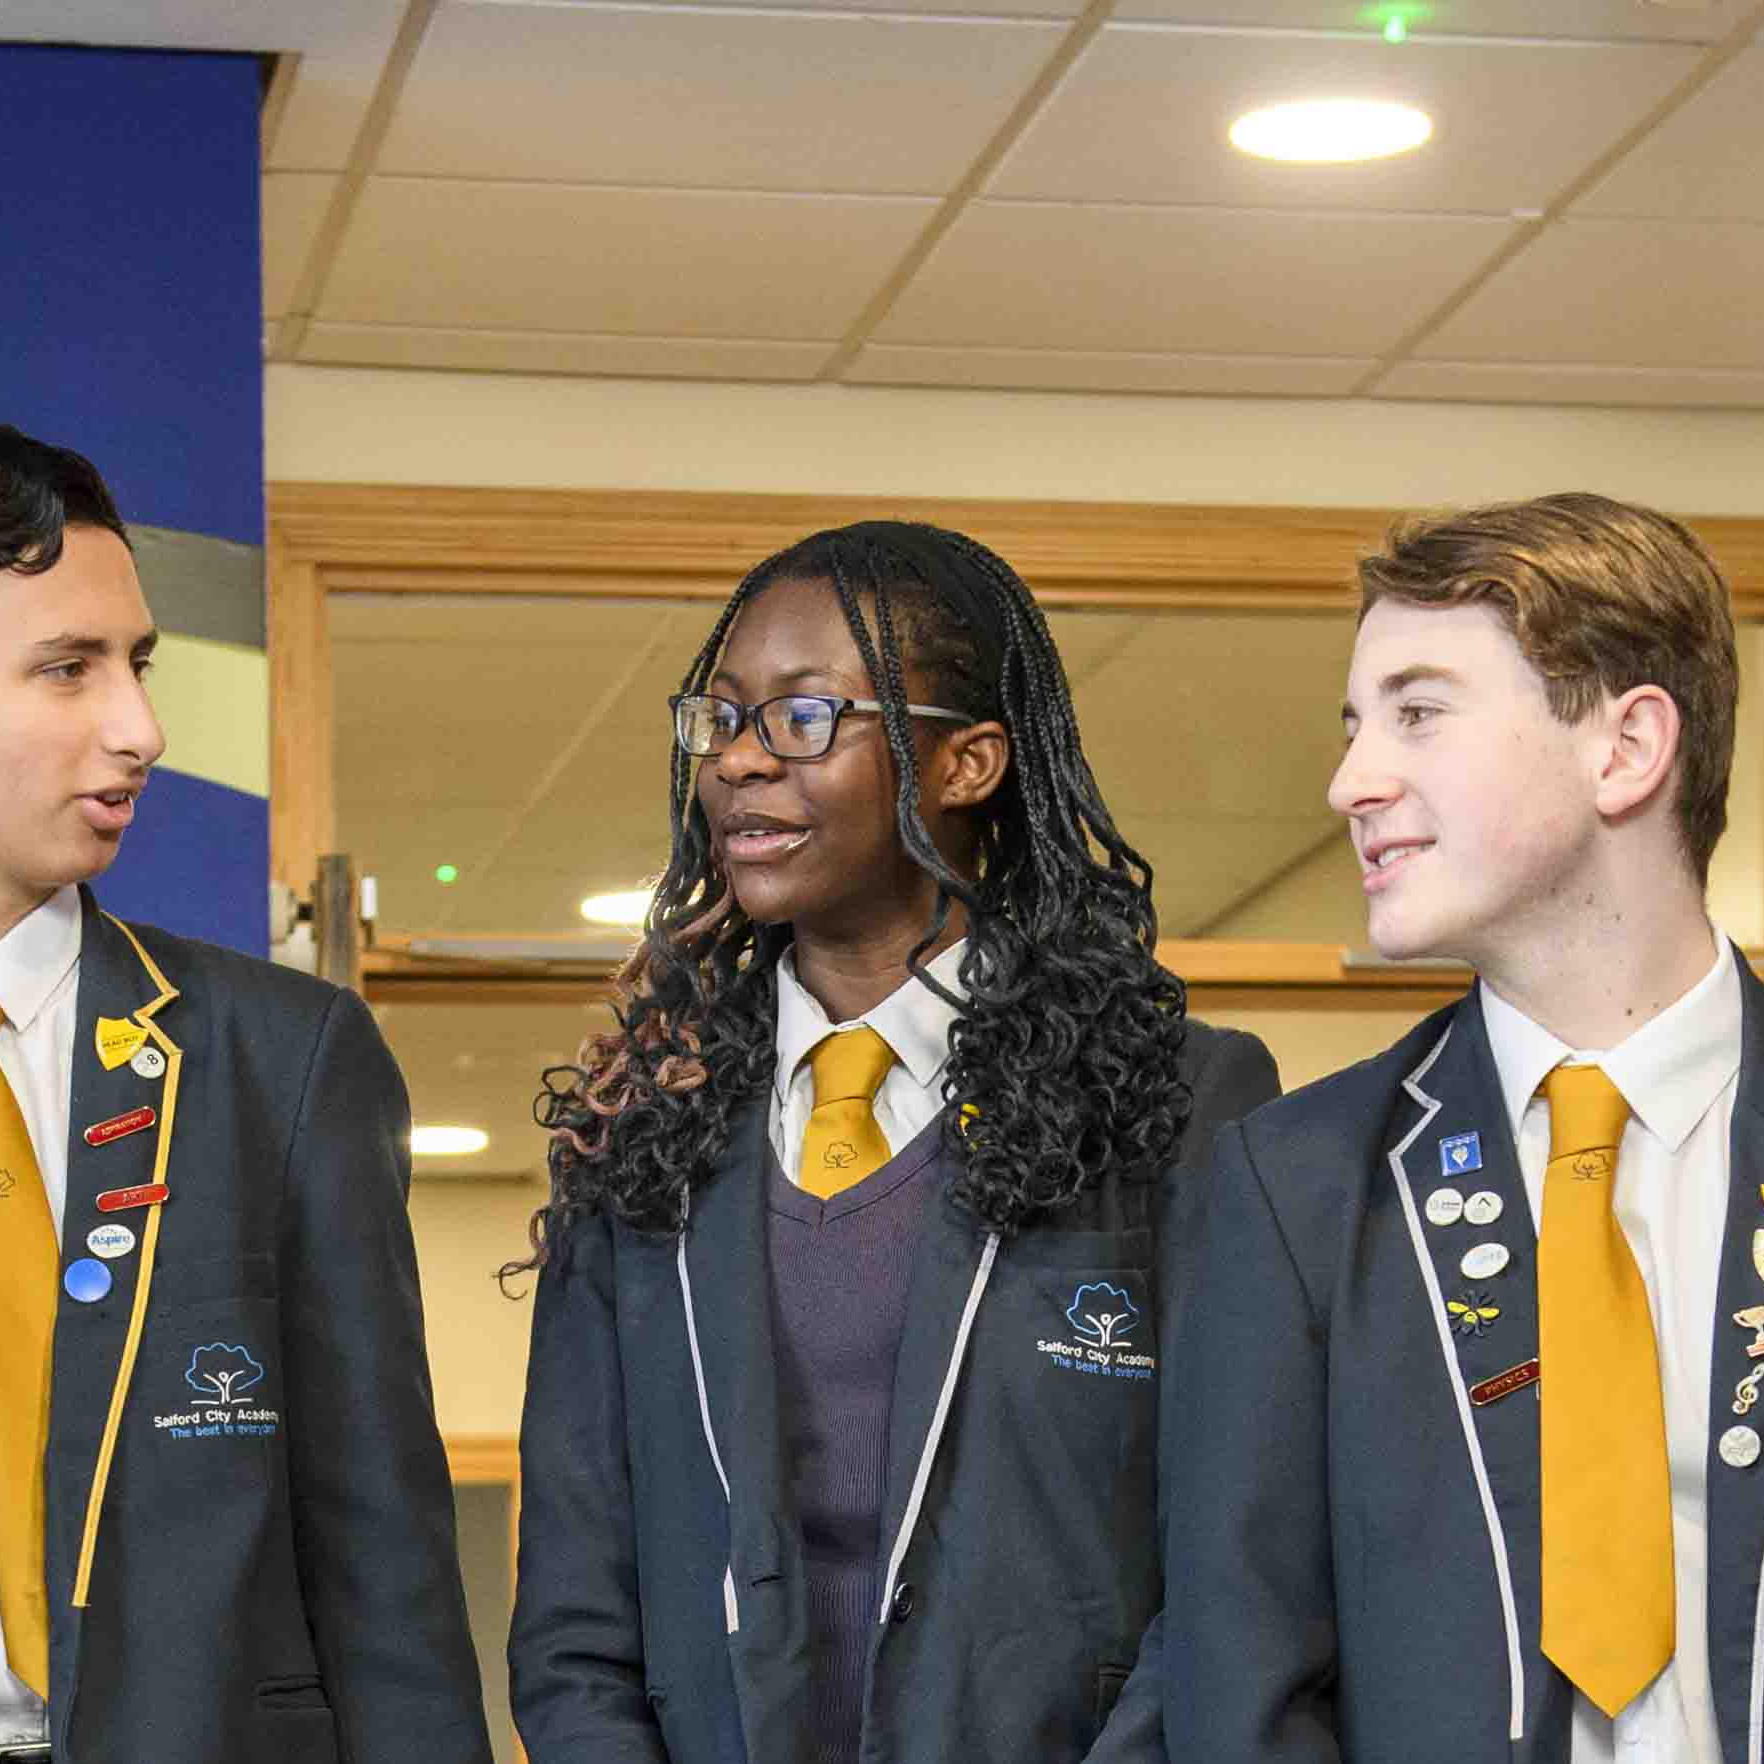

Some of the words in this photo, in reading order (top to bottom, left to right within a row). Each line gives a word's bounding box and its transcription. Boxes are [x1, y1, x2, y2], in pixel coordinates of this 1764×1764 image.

[1037, 1340, 1082, 1357] Salford
[1086, 1349, 1111, 1366] City
[1051, 1354, 1071, 1368] The
[1483, 1368, 1529, 1395] PHYSICS
[154, 1411, 201, 1428] Salford
[205, 1410, 231, 1424] City
[170, 1427, 192, 1440] The
[196, 1424, 220, 1436] best
